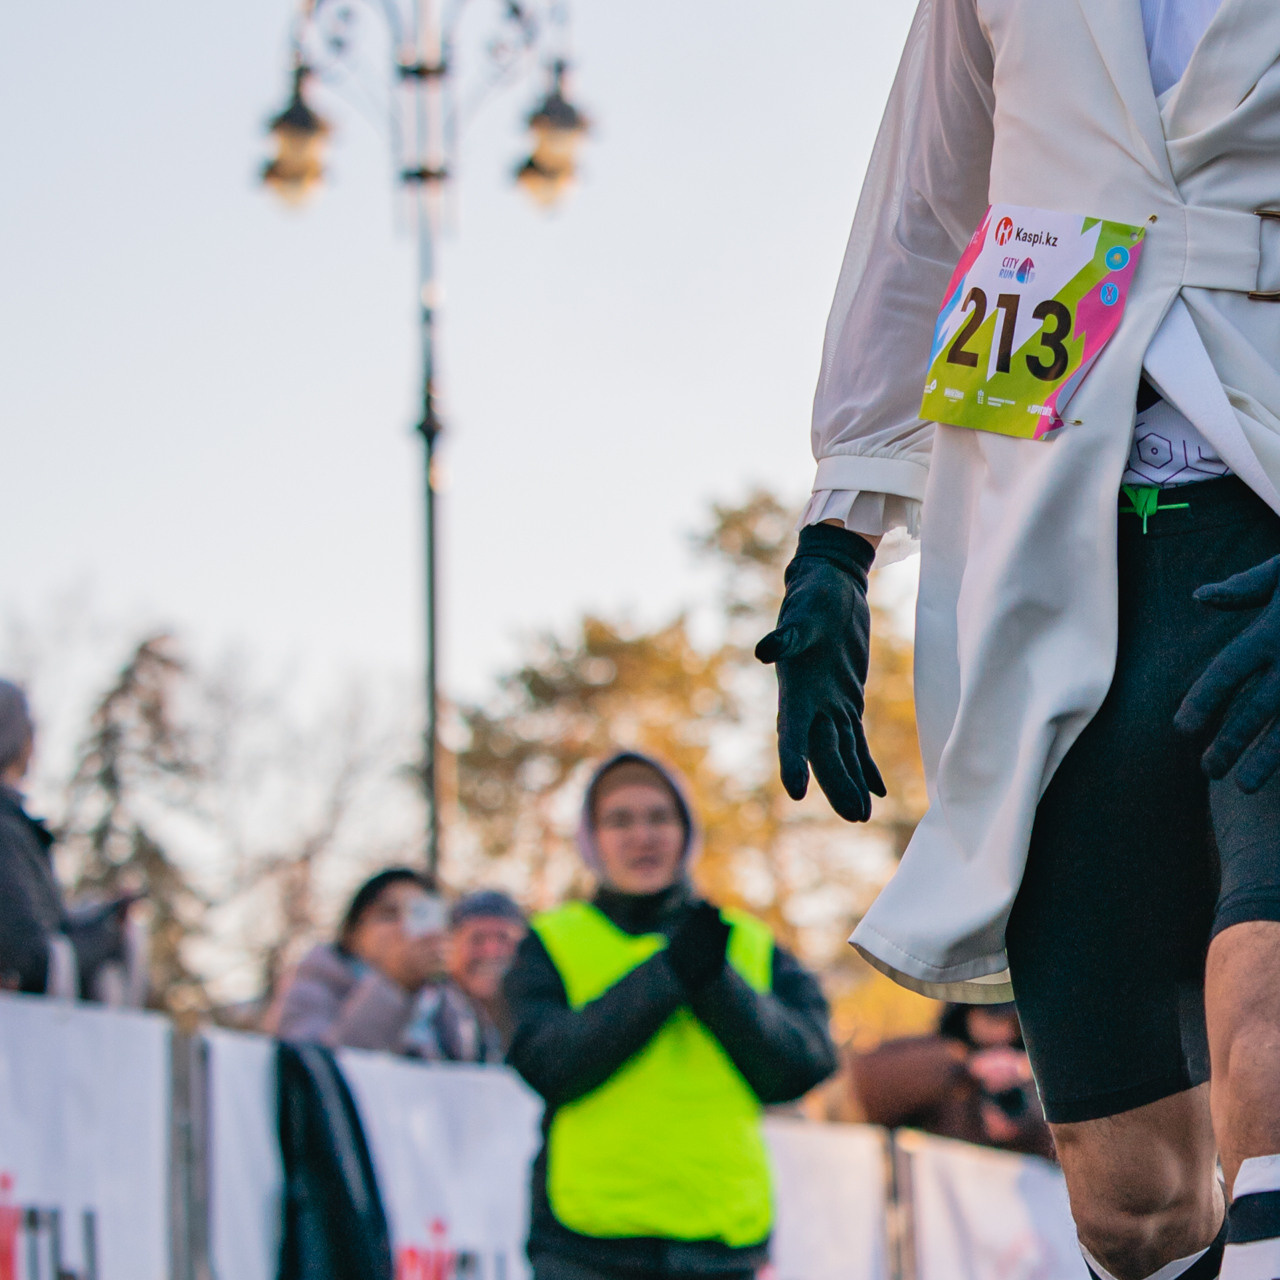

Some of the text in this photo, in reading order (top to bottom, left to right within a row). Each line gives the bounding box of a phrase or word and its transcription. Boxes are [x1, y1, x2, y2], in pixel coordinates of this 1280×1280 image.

[1015, 227, 1058, 248] Kaspi.kz
[1002, 256, 1019, 268] CITY
[999, 268, 1015, 280] RUN
[946, 287, 1072, 382] 213
